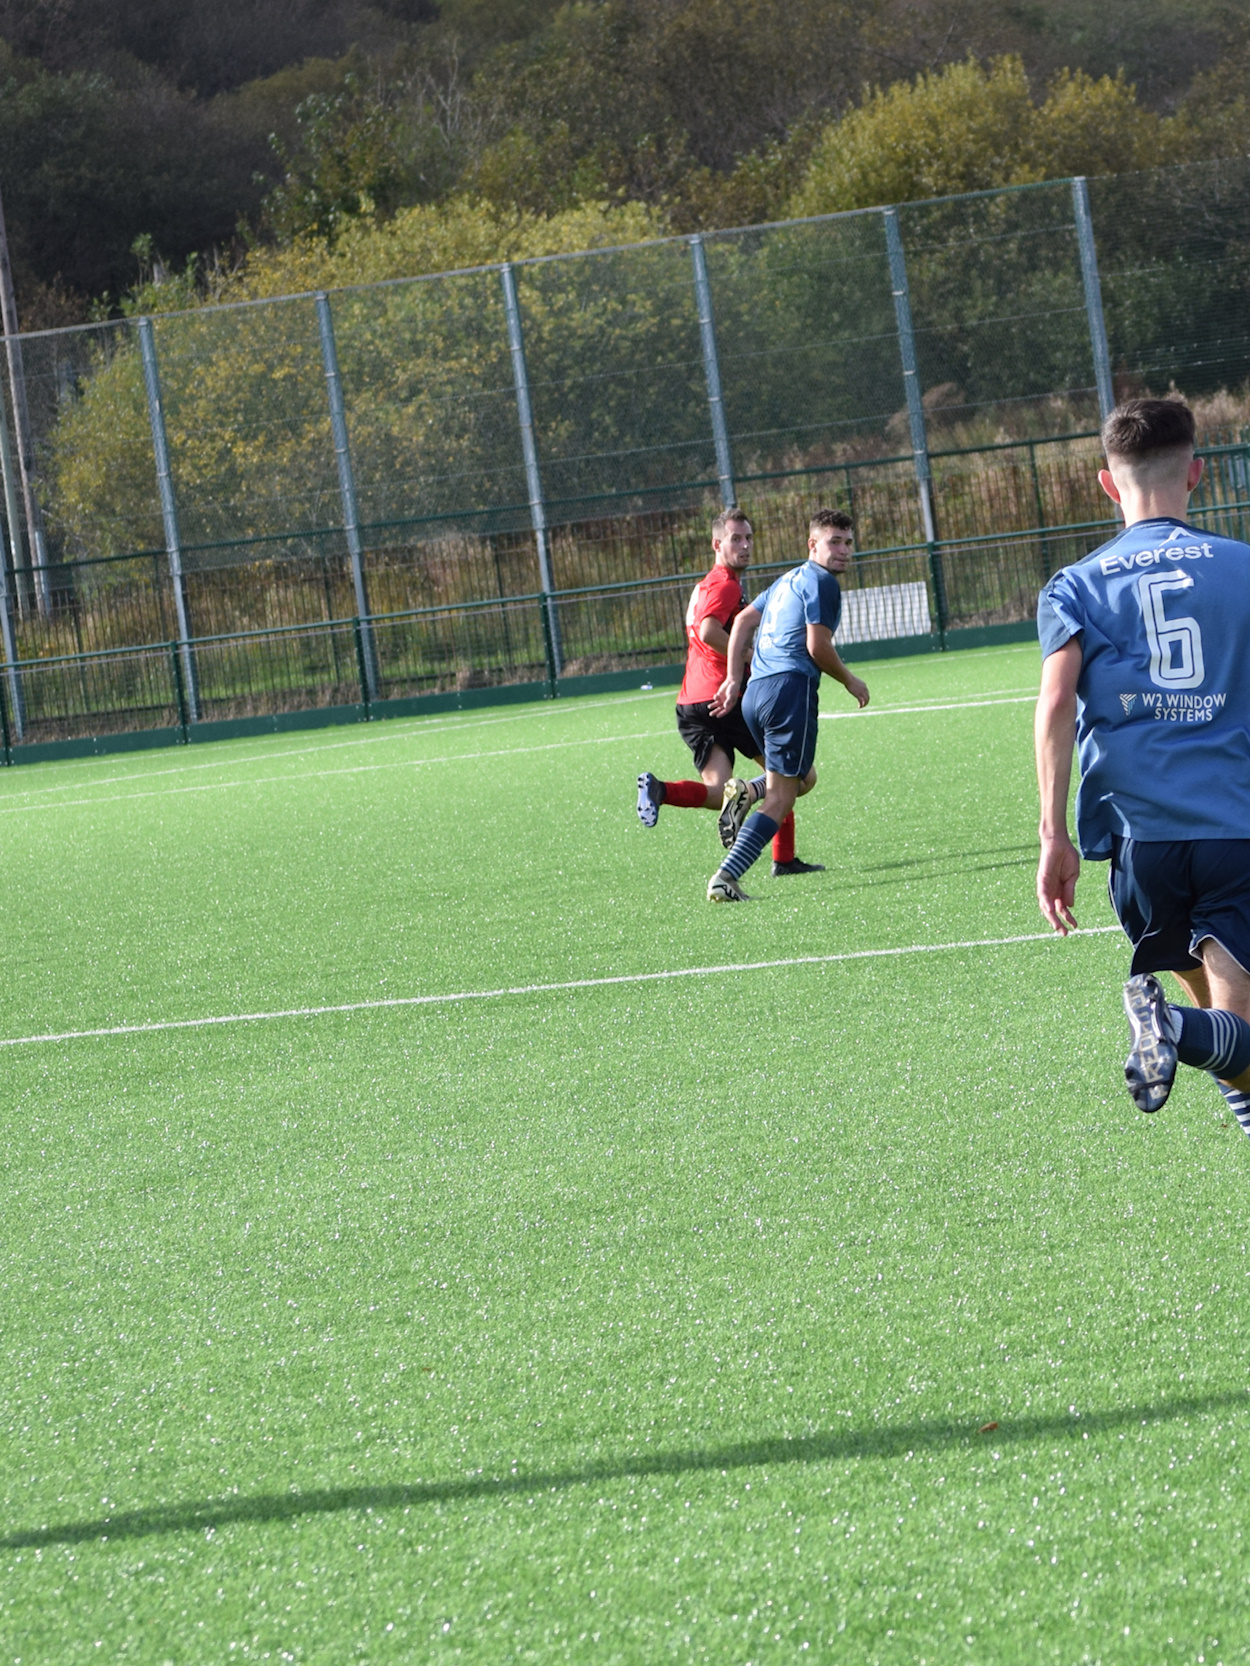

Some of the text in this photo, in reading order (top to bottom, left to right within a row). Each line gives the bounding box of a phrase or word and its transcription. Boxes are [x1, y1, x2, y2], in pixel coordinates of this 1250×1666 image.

[1100, 542, 1214, 575] Everest
[1138, 569, 1205, 690] 6
[1142, 693, 1226, 709] W2 WINDOW
[1154, 708, 1213, 722] SYSTEMS
